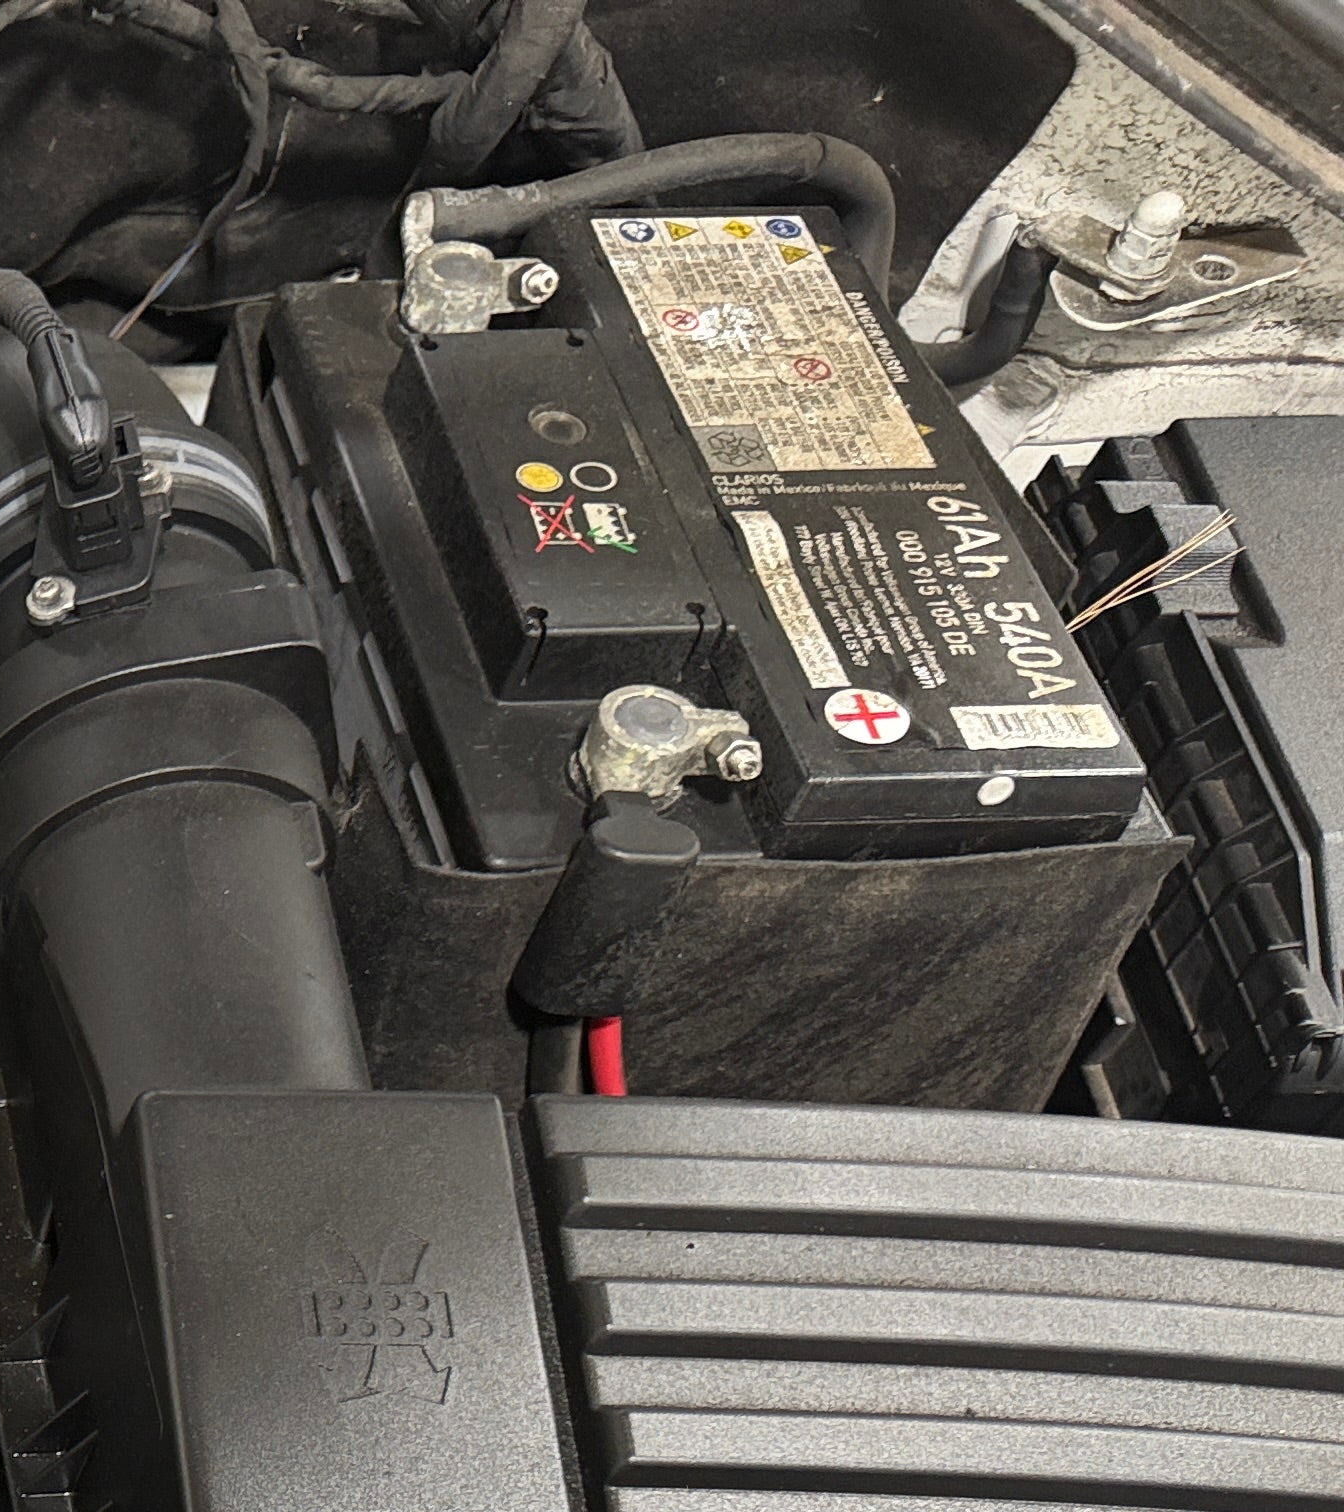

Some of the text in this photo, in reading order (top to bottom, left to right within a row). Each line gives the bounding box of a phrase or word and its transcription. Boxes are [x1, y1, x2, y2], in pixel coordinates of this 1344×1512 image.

[896, 530, 976, 657] 000 915 105 DE
[927, 496, 1076, 699] 61Ah 540A
[934, 553, 956, 577] 12V
